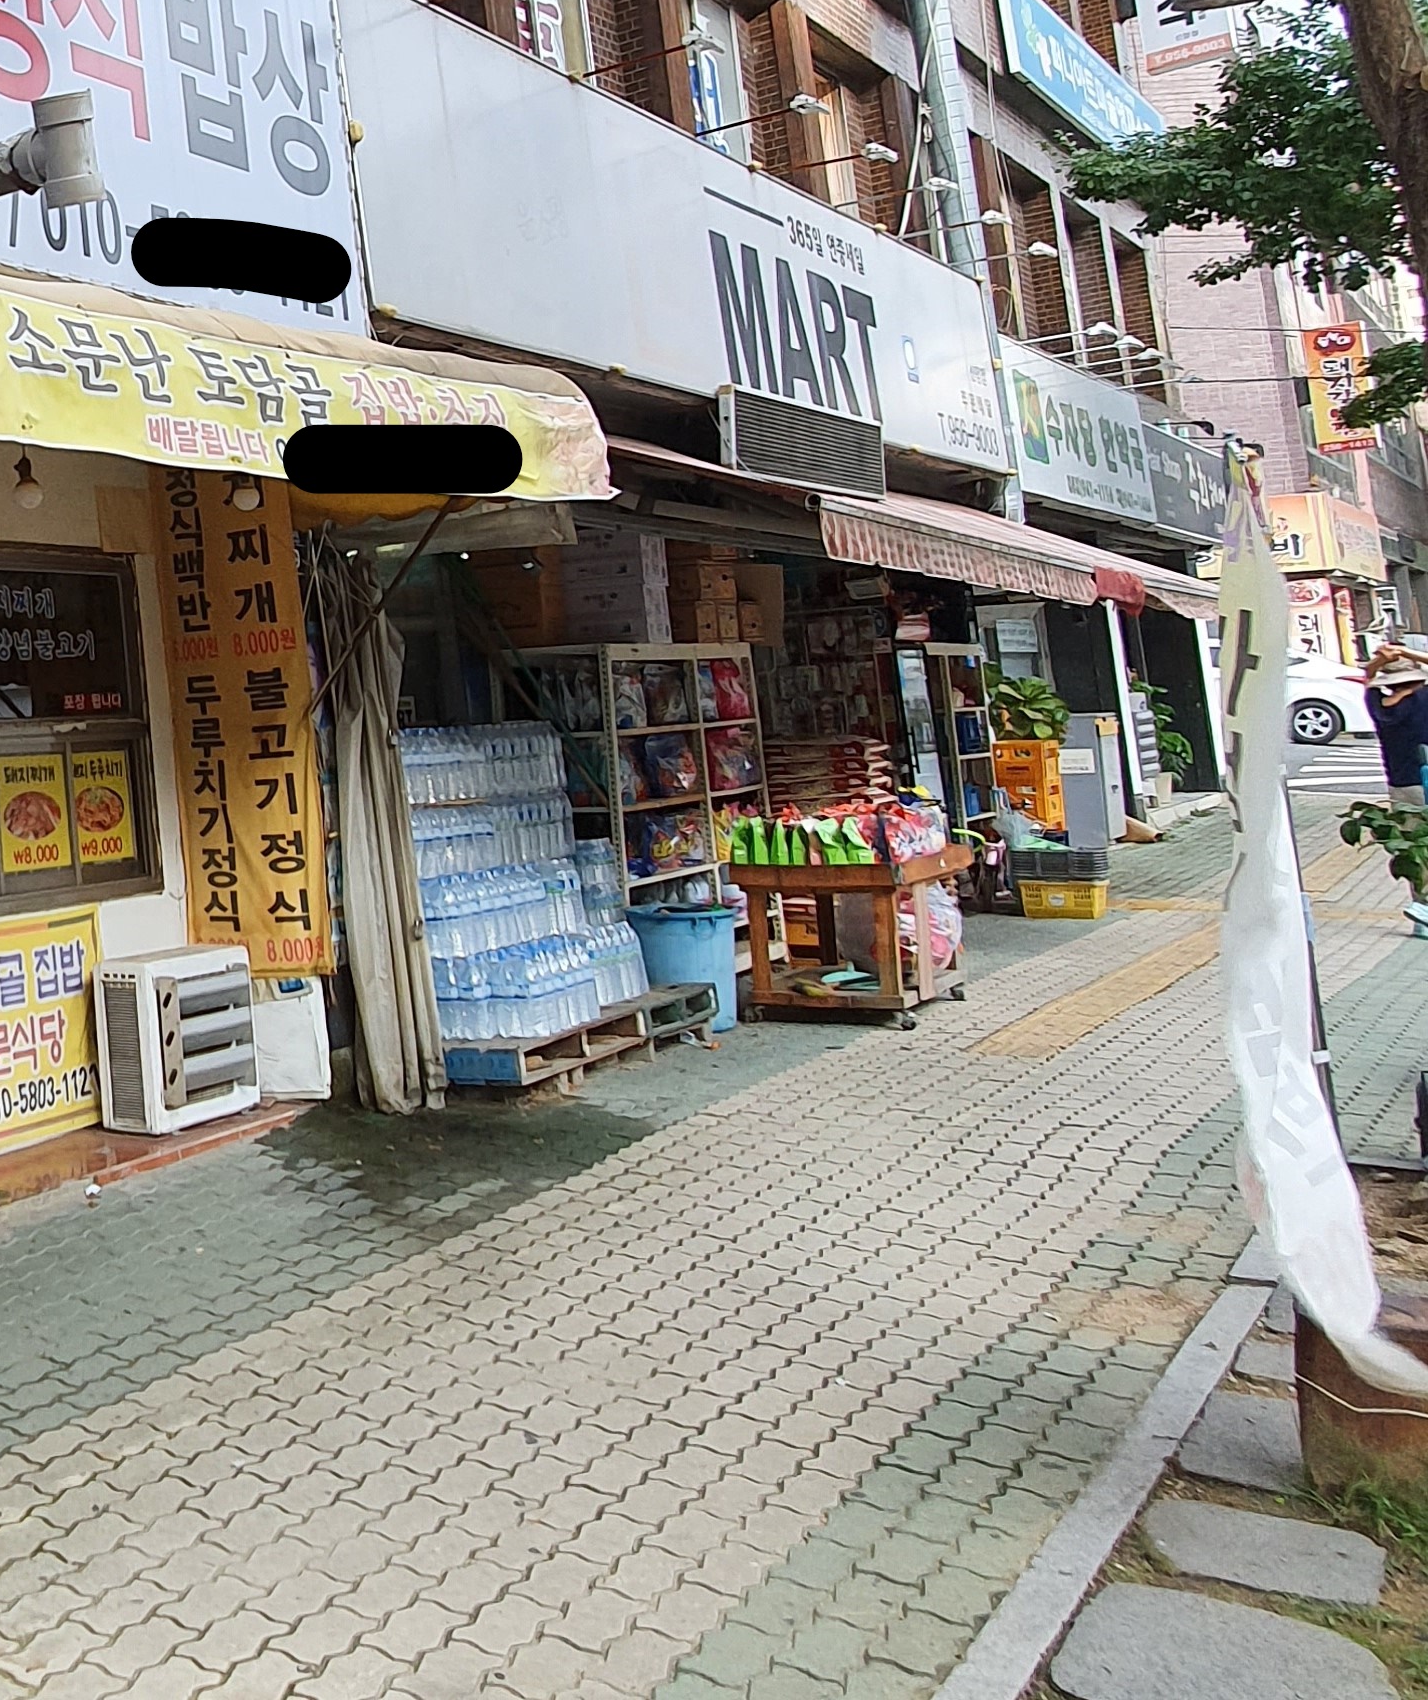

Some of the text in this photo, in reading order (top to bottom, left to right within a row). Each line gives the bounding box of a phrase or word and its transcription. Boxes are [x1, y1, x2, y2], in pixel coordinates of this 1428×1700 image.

[786, 214, 826, 258] 365일
[8, 305, 173, 405] 소문난
[189, 344, 335, 428] 토담골
[709, 228, 884, 426] MART
[146, 417, 270, 464] 배달됩니다
[185, 673, 241, 934] 두루치기정식
[243, 665, 312, 933] 불고기정식
[33, 939, 85, 1000] 집밥
